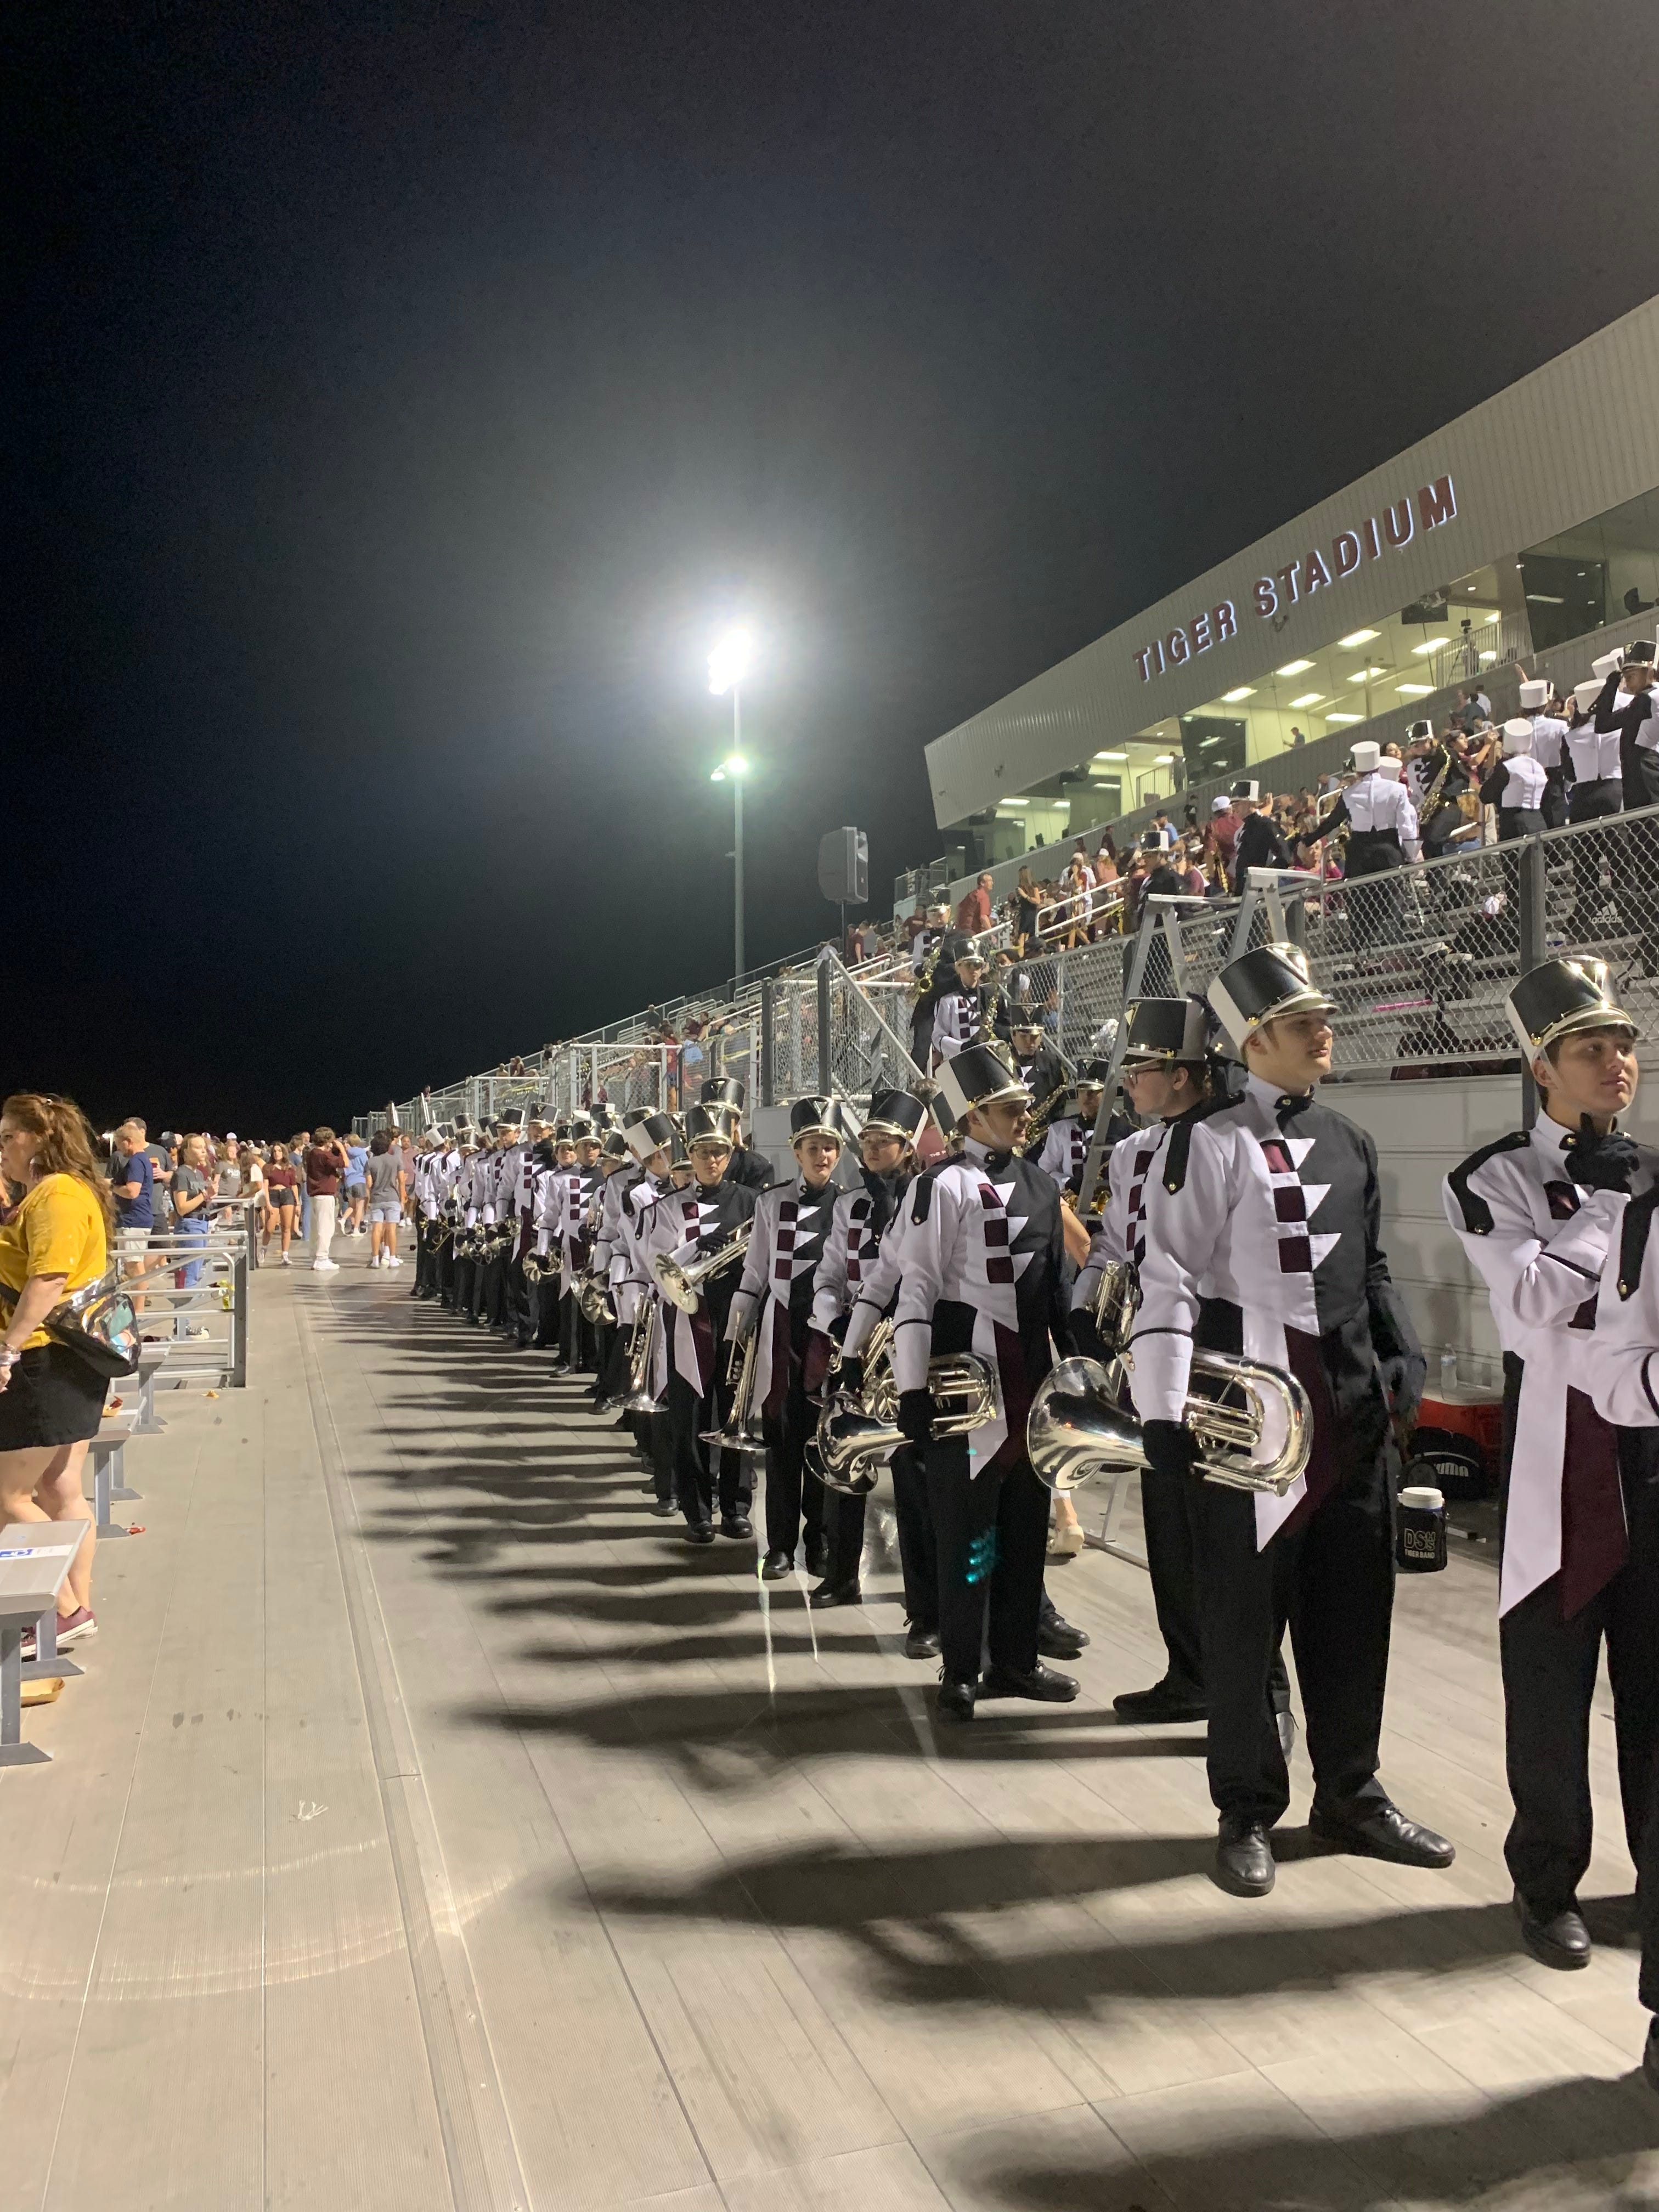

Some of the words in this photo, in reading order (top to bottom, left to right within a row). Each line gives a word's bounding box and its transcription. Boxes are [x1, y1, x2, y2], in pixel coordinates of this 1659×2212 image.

[1132, 601, 1237, 682] TIGER
[1253, 475, 1457, 617] STADIUM
[1434, 1463, 1469, 1477] UMA
[1420, 1551, 1435, 1559] BAND
